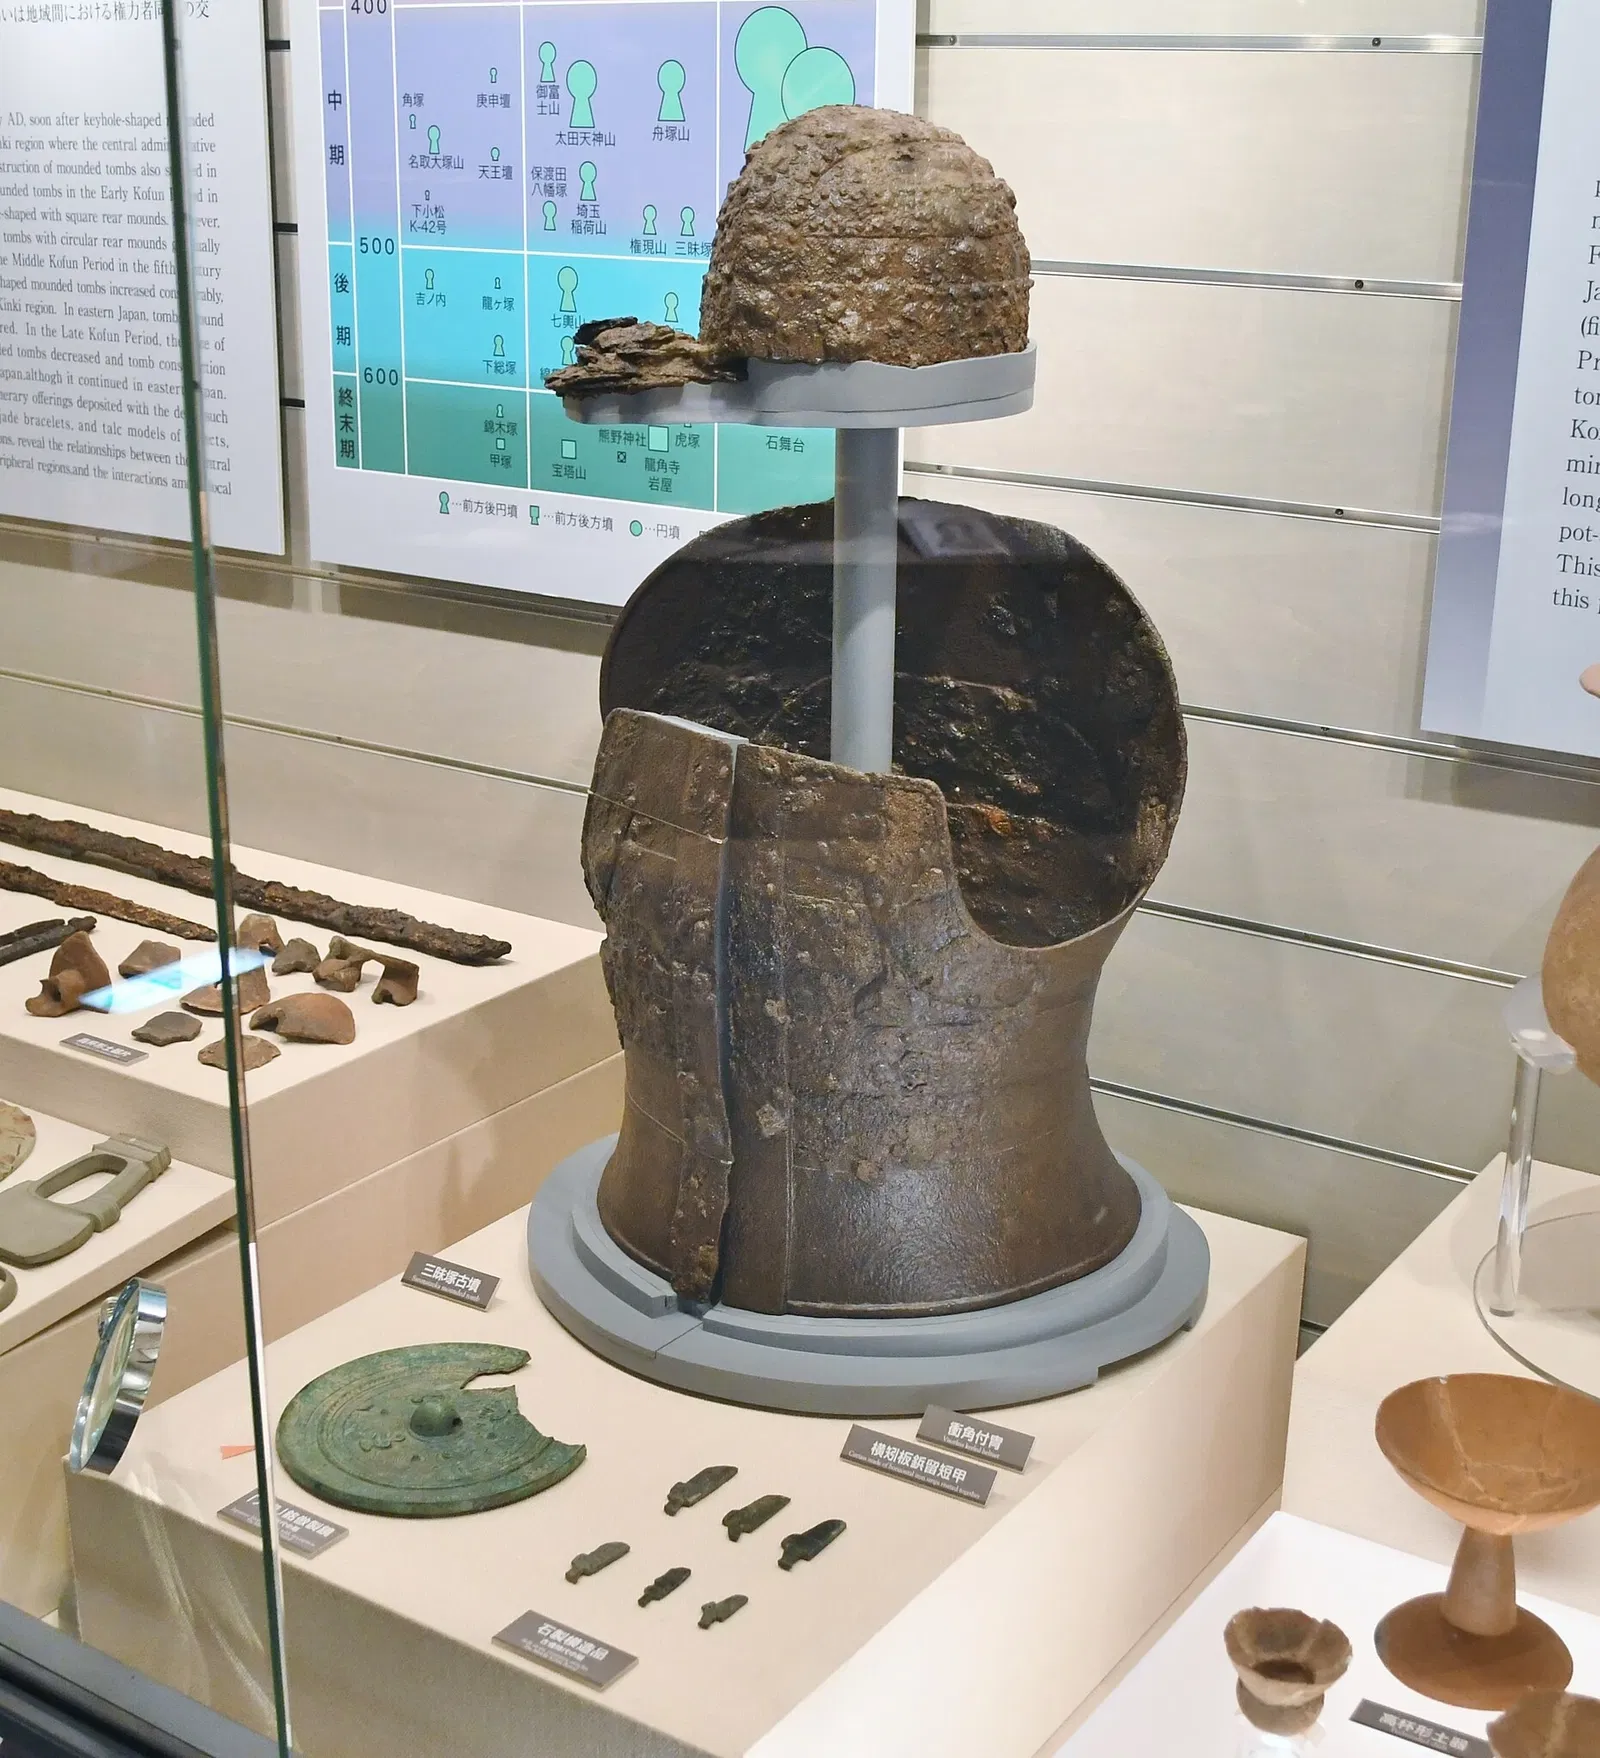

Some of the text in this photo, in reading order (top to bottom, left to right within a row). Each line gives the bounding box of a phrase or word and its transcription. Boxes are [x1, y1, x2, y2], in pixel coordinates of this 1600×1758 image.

[351, 0, 388, 14] 400
[402, 93, 424, 108] 角塚
[476, 93, 511, 108] 庚申壇
[30, 116, 52, 126] soon
[56, 112, 80, 126] after
[84, 112, 162, 130] keyhole-shaped
[555, 131, 616, 147] 太田天神山
[652, 126, 690, 142] 舟塚山
[15, 136, 44, 152] region
[48, 136, 78, 150] where
[82, 136, 98, 150] the
[102, 137, 137, 151] central
[44, 160, 54, 174] of
[56, 160, 102, 175] mounded
[106, 161, 136, 176] tombs
[140, 161, 161, 176] also
[207, 163, 217, 178] in
[408, 154, 464, 170] 名取大塚山
[478, 165, 514, 180] 天王壇
[531, 167, 567, 182] 保渡田
[32, 184, 62, 198] tombs
[66, 184, 76, 198] in
[80, 185, 96, 199] the
[100, 185, 128, 202] Early
[133, 186, 164, 201] Kofun
[208, 188, 218, 203] in
[531, 183, 568, 198] 八幡塚
[40, 207, 62, 222] with
[66, 212, 98, 225] square
[102, 213, 122, 224] rear
[412, 204, 444, 220] 下小松
[576, 204, 600, 219] 埼玉
[410, 220, 446, 235] K-42号
[570, 220, 607, 235] 稲荷山
[3, 230, 32, 244] tombs
[36, 230, 57, 245] with
[60, 232, 98, 247] circular
[102, 238, 123, 248] rear
[128, 236, 168, 250] mounds
[360, 238, 395, 256] 500
[630, 239, 667, 256] 権現山
[12, 252, 44, 268] Middle
[48, 254, 78, 270] Kofun
[82, 256, 114, 272] Period
[118, 258, 128, 272] in
[132, 260, 150, 274] the
[154, 260, 176, 276] fifth
[30, 278, 73, 293] mounded
[76, 280, 106, 295] tombs
[110, 280, 156, 298] increased
[25, 300, 57, 316] region.
[64, 302, 74, 316] In
[78, 306, 114, 318] eastern
[416, 292, 446, 308] 吉ノ内
[26, 322, 36, 336] In
[41, 324, 57, 338] the
[61, 324, 84, 340] Late
[88, 326, 120, 342] Kofun
[214, 336, 225, 352] of
[17, 346, 47, 360] tombs
[50, 347, 101, 364] decreased
[104, 352, 124, 366] and
[128, 355, 154, 370] tomb
[364, 367, 398, 386] 600
[482, 360, 516, 375] 下総塚
[66, 372, 74, 385] it
[78, 374, 128, 390] continued
[133, 377, 143, 392] in
[32, 391, 74, 409] offerings
[76, 395, 122, 412] deposited
[126, 400, 150, 416] with
[154, 404, 170, 418] the
[78, 420, 98, 433] and
[102, 422, 122, 436] talc
[128, 424, 166, 441] models
[170, 428, 181, 443] of
[338, 386, 354, 460] 終末期
[598, 429, 647, 448] 熊野神社
[674, 432, 700, 449] 虎塚
[766, 434, 805, 452] 石舞台
[18, 436, 45, 450] reveal
[48, 436, 64, 452] the
[67, 440, 126, 460] relationships
[130, 446, 172, 464] between
[490, 453, 512, 468] 甲塚
[644, 457, 681, 475] 龍角寺
[92, 464, 109, 480] the
[112, 467, 168, 488] interactions
[552, 463, 587, 480] 宝塔山
[648, 476, 673, 493] 岩屋
[1552, 587, 1590, 610] this
[420, 1262, 482, 1292] 三昧塚古墳
